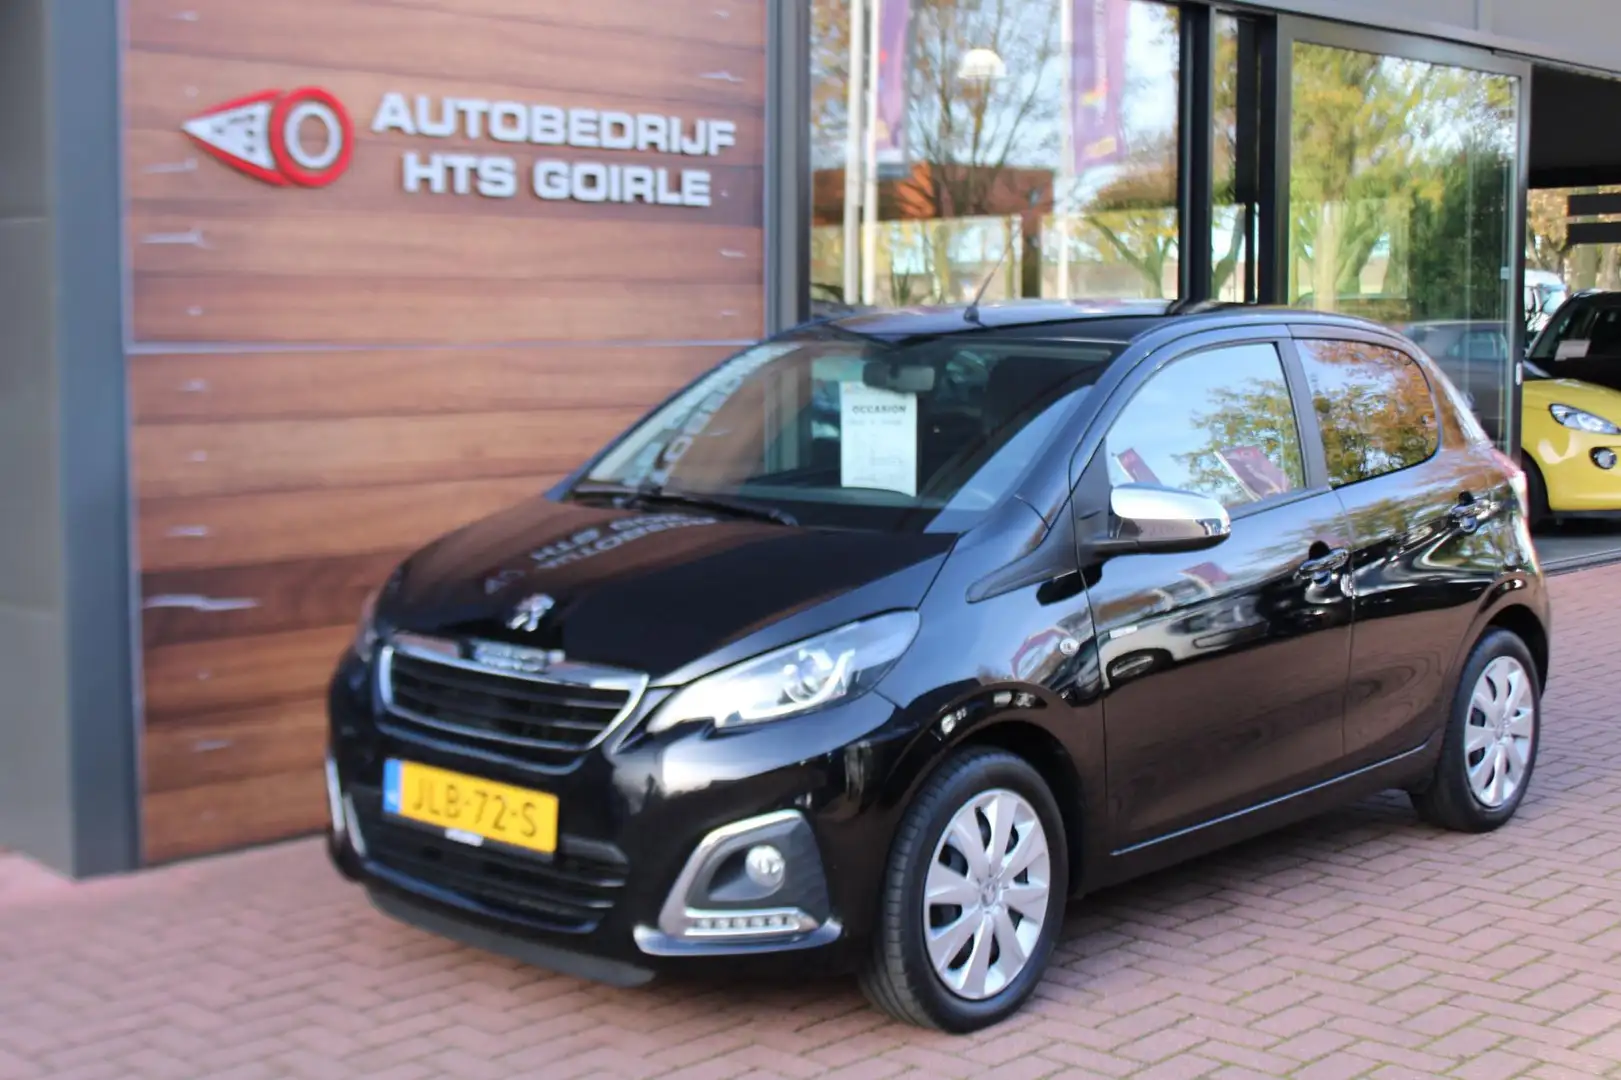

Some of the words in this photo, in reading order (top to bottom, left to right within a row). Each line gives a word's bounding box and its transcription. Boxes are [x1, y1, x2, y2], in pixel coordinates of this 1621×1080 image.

[372, 92, 736, 155] AUTOBEDRIJF
[402, 152, 517, 198] HTS
[532, 161, 713, 207] GOIRLE
[852, 405, 907, 414] OCCASION
[412, 778, 538, 837] JLB-72-S
